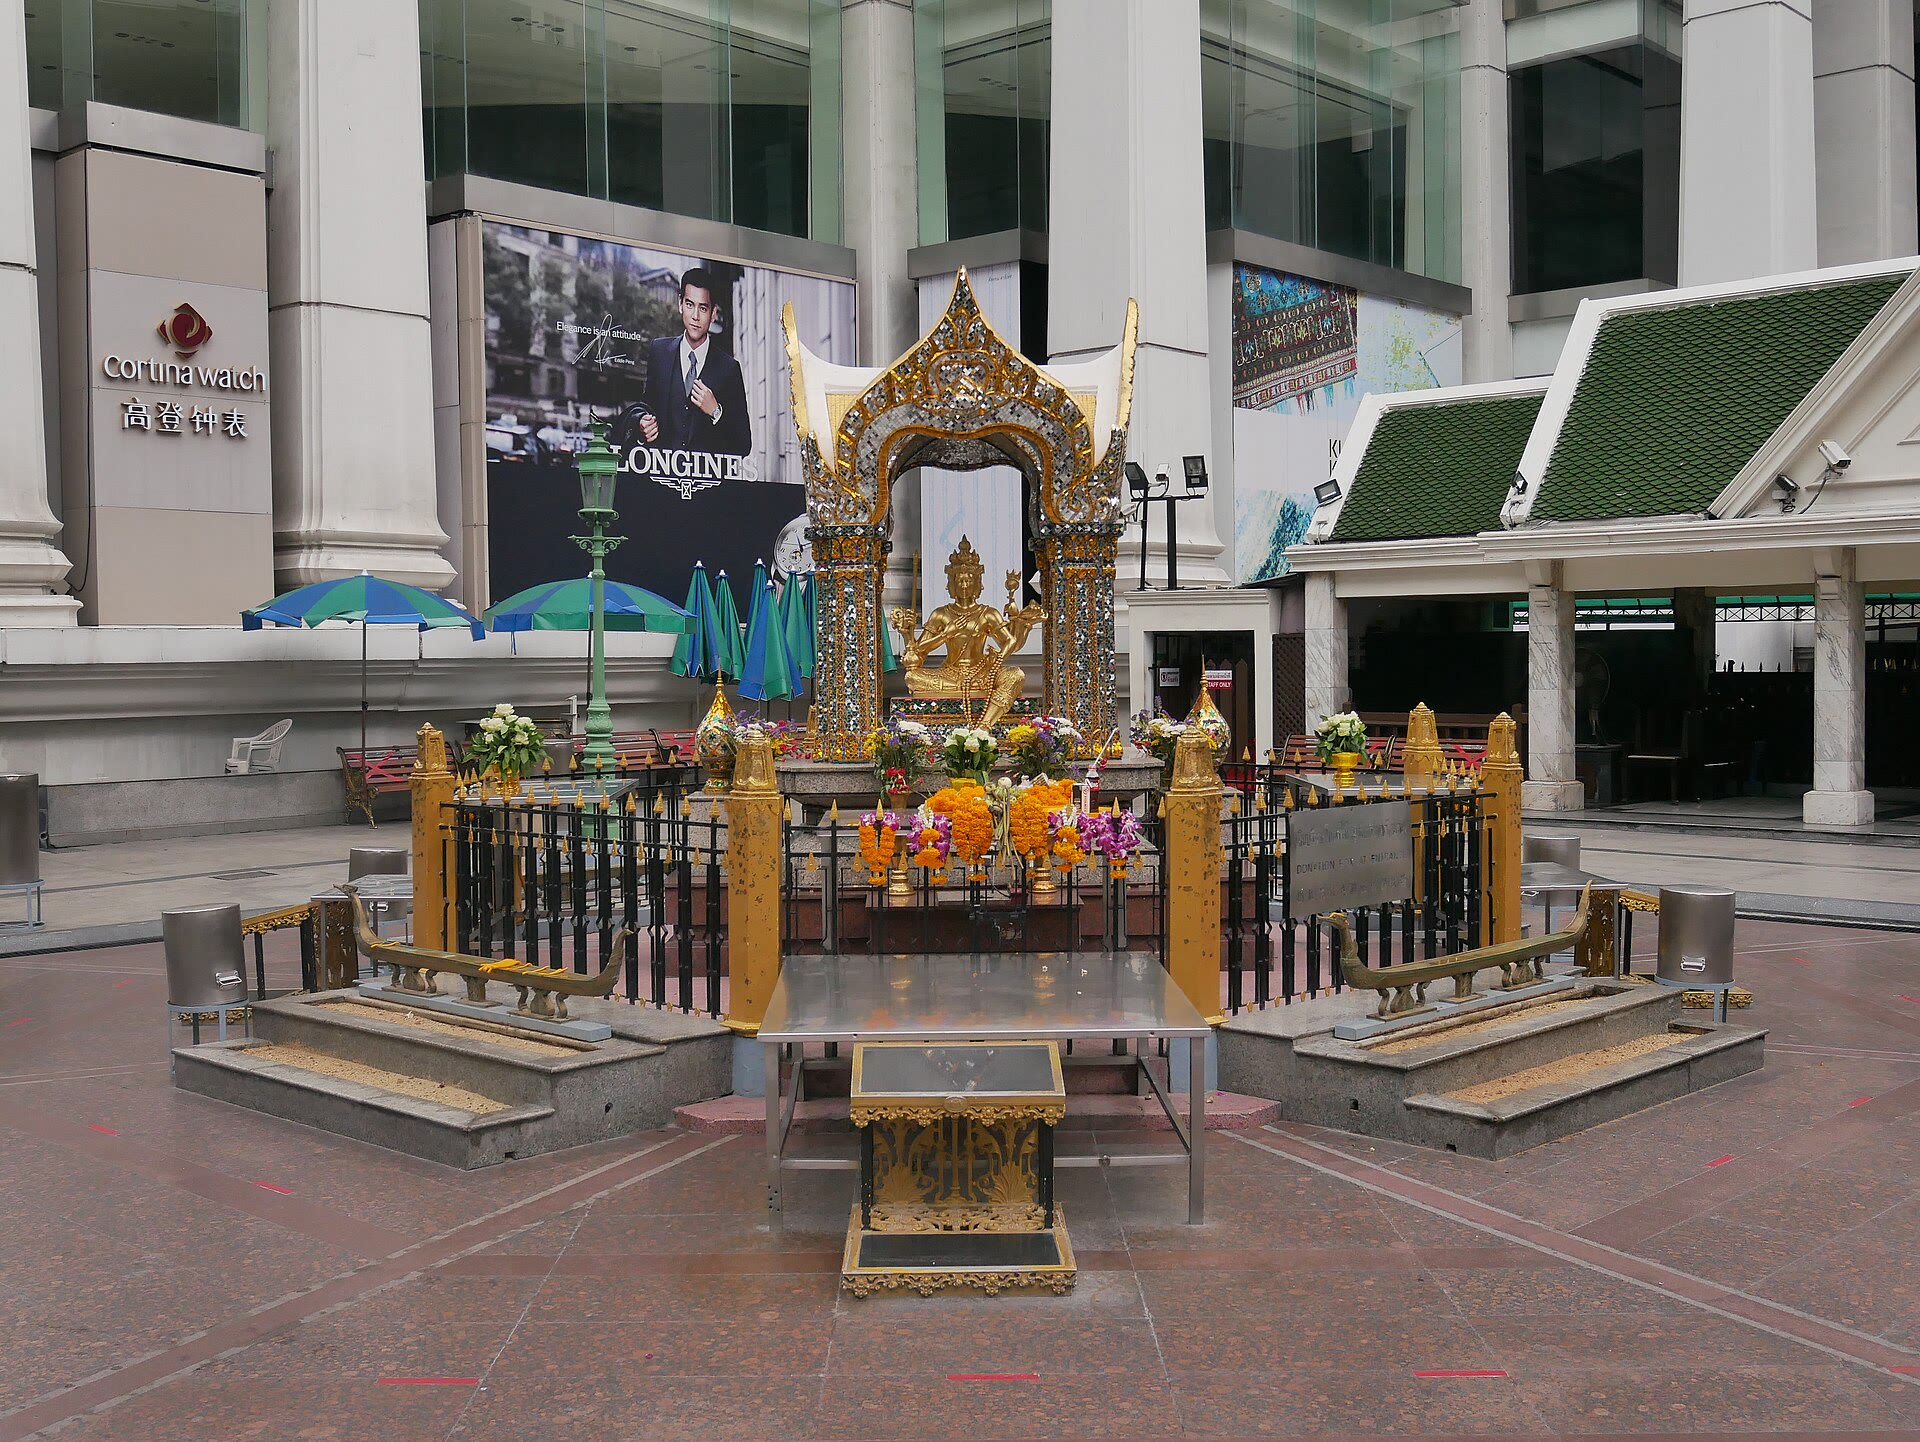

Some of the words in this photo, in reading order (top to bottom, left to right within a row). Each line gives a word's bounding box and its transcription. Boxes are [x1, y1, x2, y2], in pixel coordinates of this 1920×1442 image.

[556, 321, 592, 334] Elegance
[593, 327, 600, 336] is
[600, 329, 611, 337] an
[612, 329, 641, 341] attitude
[197, 365, 266, 391] watch
[121, 396, 249, 438] 高登钟表
[609, 444, 759, 482] LONGINES
